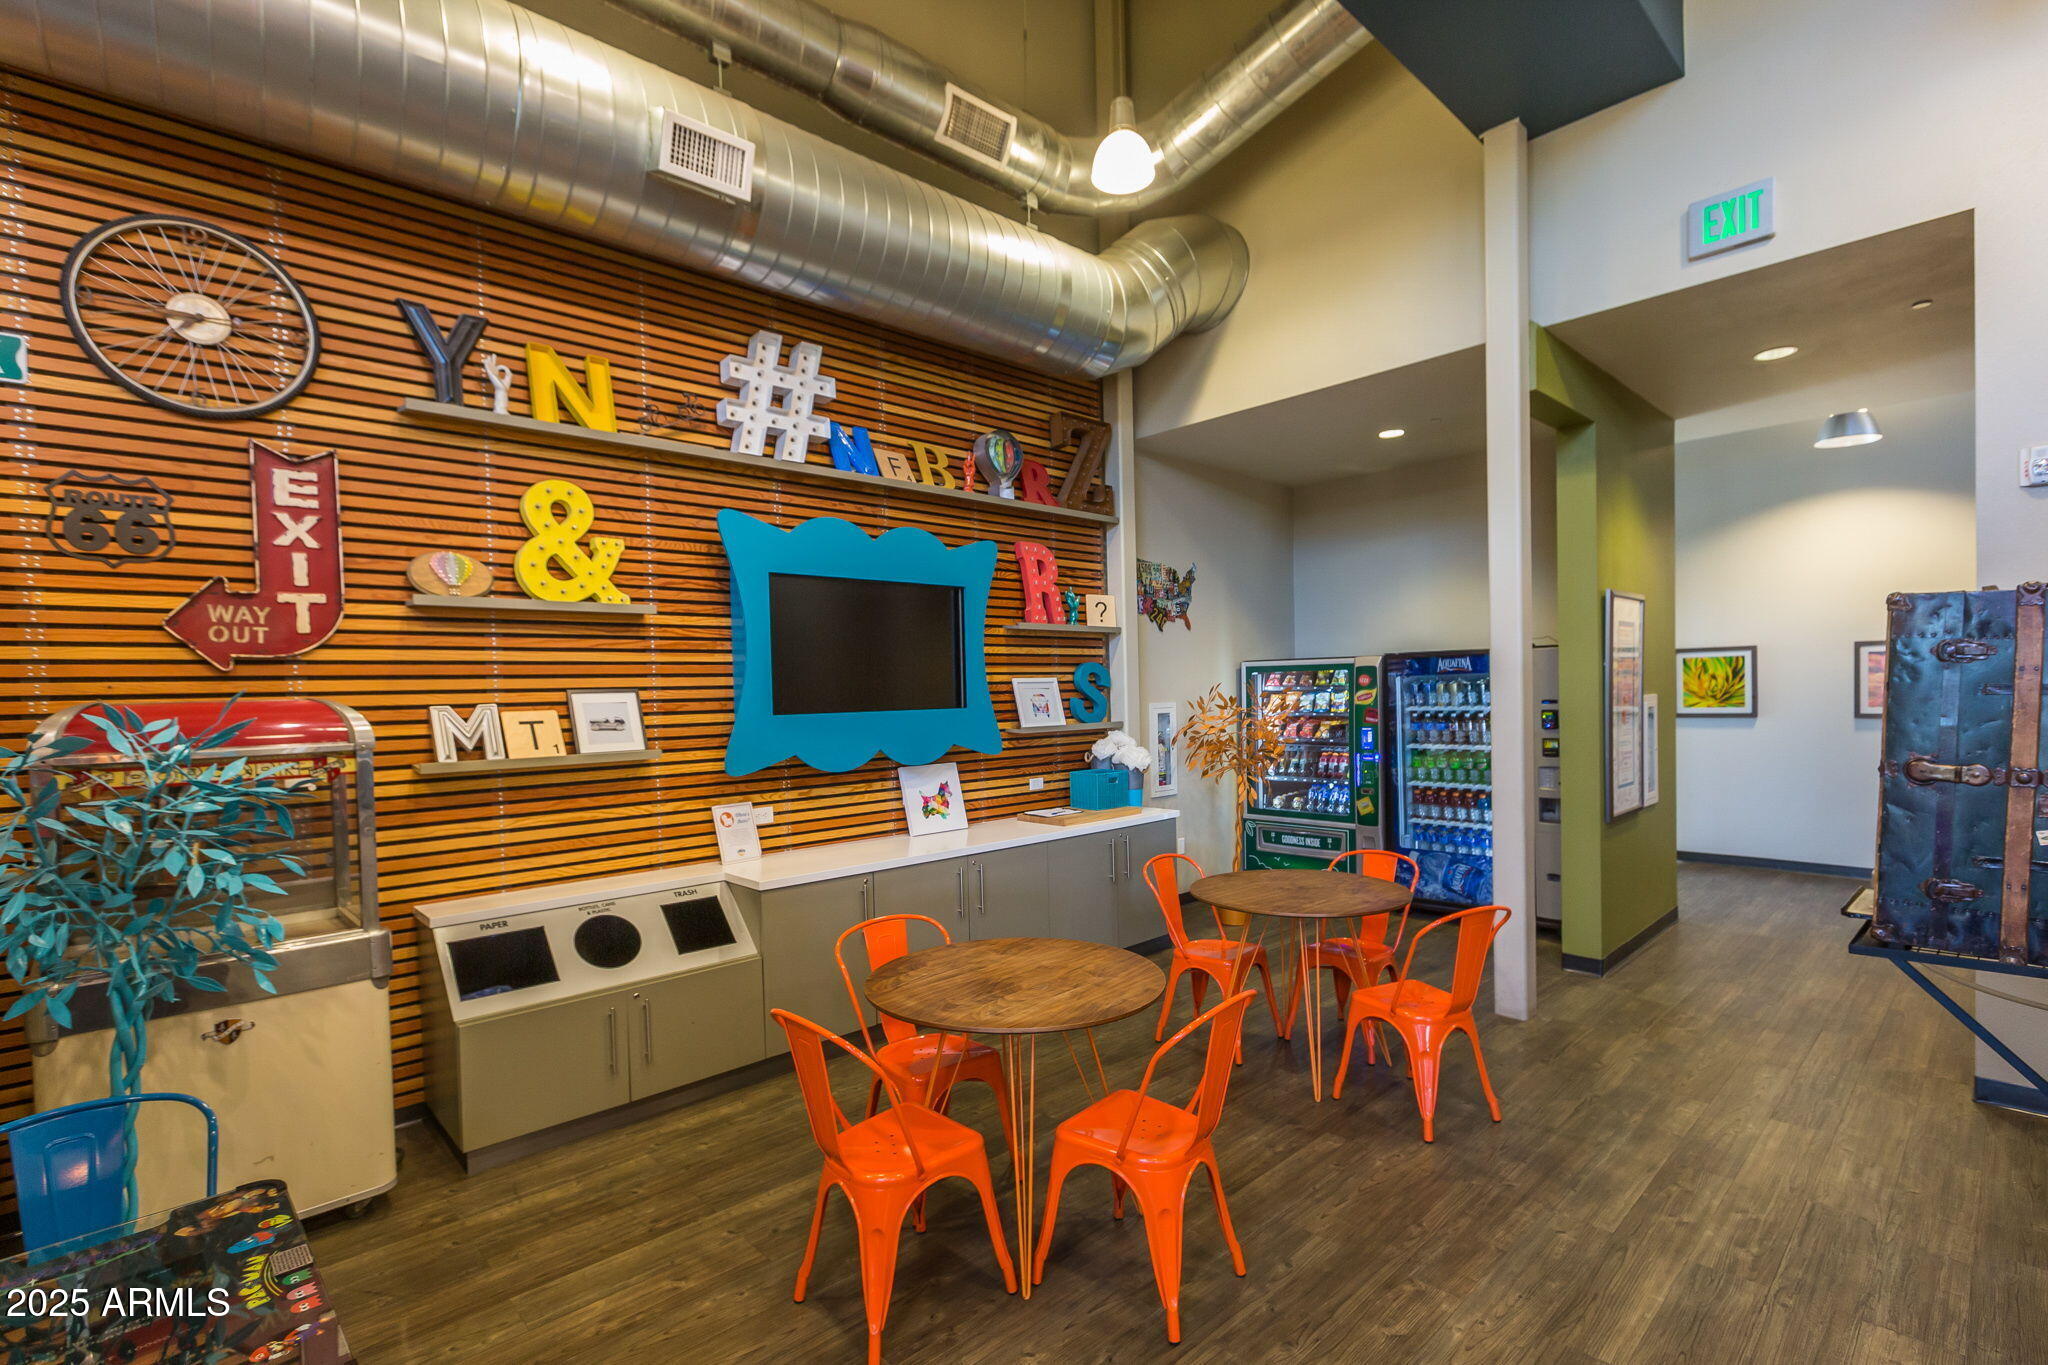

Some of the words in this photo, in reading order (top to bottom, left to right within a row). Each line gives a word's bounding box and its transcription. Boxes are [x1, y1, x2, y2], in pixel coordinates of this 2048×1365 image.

[1703, 188, 1764, 245] EXIT
[397, 299, 487, 403] Y
[525, 342, 618, 433] N
[829, 421, 880, 477] N
[907, 440, 956, 490] B
[63, 489, 158, 510] ROUTE
[1020, 458, 1061, 507] R
[62, 505, 161, 555] 66
[271, 467, 328, 635] EXIT
[514, 479, 631, 604] &
[1014, 541, 1067, 625] R
[206, 603, 272, 625] WAY
[207, 625, 270, 644] OUT
[1094, 601, 1108, 623] ?
[1437, 656, 1472, 673] AQUAFINA
[1069, 661, 1112, 723] S
[428, 703, 506, 763] M
[518, 720, 545, 750] T
[552, 743, 560, 754] 1
[1281, 834, 1305, 846] GOODNESS
[1305, 837, 1321, 848] INSIDE
[673, 888, 698, 898] TRASH
[479, 920, 508, 932] PAPER
